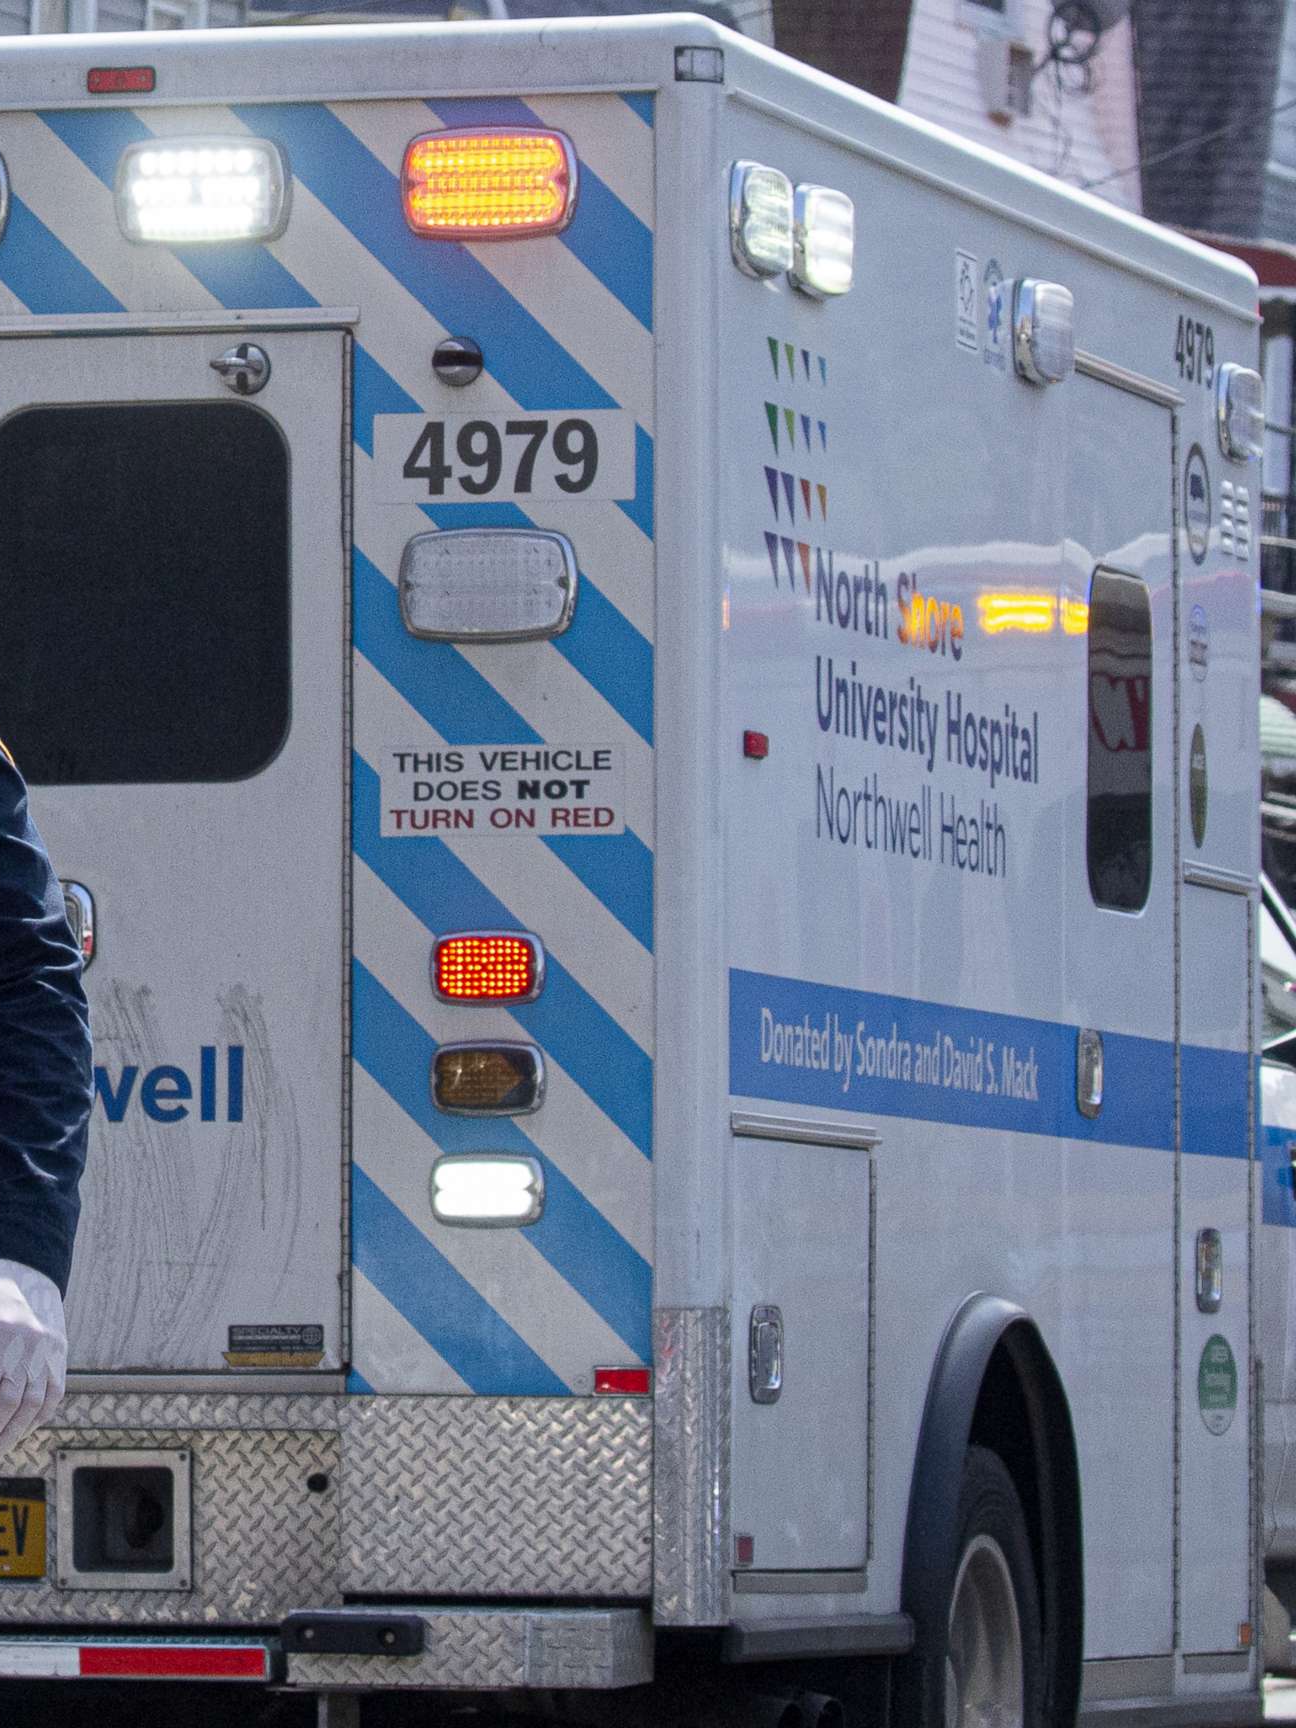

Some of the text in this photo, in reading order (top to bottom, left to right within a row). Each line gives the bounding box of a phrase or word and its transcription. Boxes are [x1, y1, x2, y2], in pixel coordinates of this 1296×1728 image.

[1175, 314, 1215, 391] 4979
[403, 418, 599, 495] 4979
[816, 547, 964, 662] North Shore
[816, 655, 1039, 789] University Hospital
[393, 750, 612, 773] THIS VEHICLE
[413, 779, 590, 801] DOES NOT
[389, 806, 615, 830] TURN ON RED
[816, 763, 1006, 878] Northwell Health
[761, 1007, 1039, 1101] Donated by Sondra and David S. Mack
